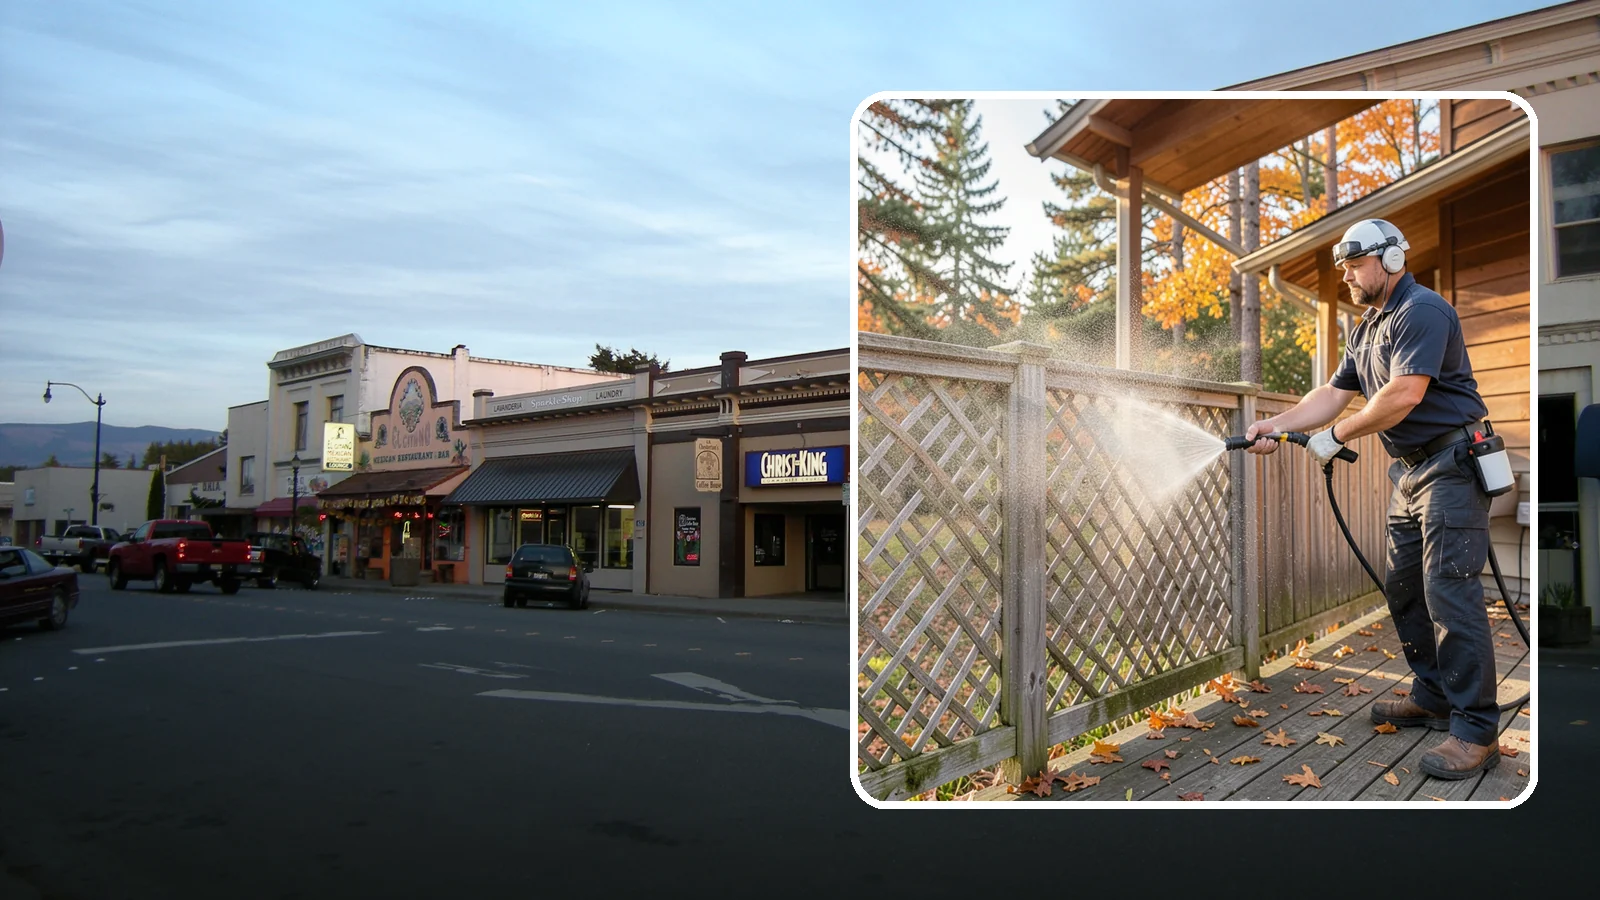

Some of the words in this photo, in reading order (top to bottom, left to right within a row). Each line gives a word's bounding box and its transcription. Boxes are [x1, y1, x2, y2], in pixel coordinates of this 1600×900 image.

[493, 402, 522, 413] LAVANDERIA
[530, 397, 561, 409] Sparkle
[560, 394, 583, 405] Shop
[595, 389, 623, 400] LAUNDRY
[392, 425, 402, 449] EL
[327, 449, 352, 457] MEXICAN
[373, 454, 396, 464] MEXICAN
[397, 451, 434, 462] RESTAURANT
[438, 450, 450, 459] BAR
[761, 451, 797, 478] CHRIST
[798, 449, 827, 476] KING
